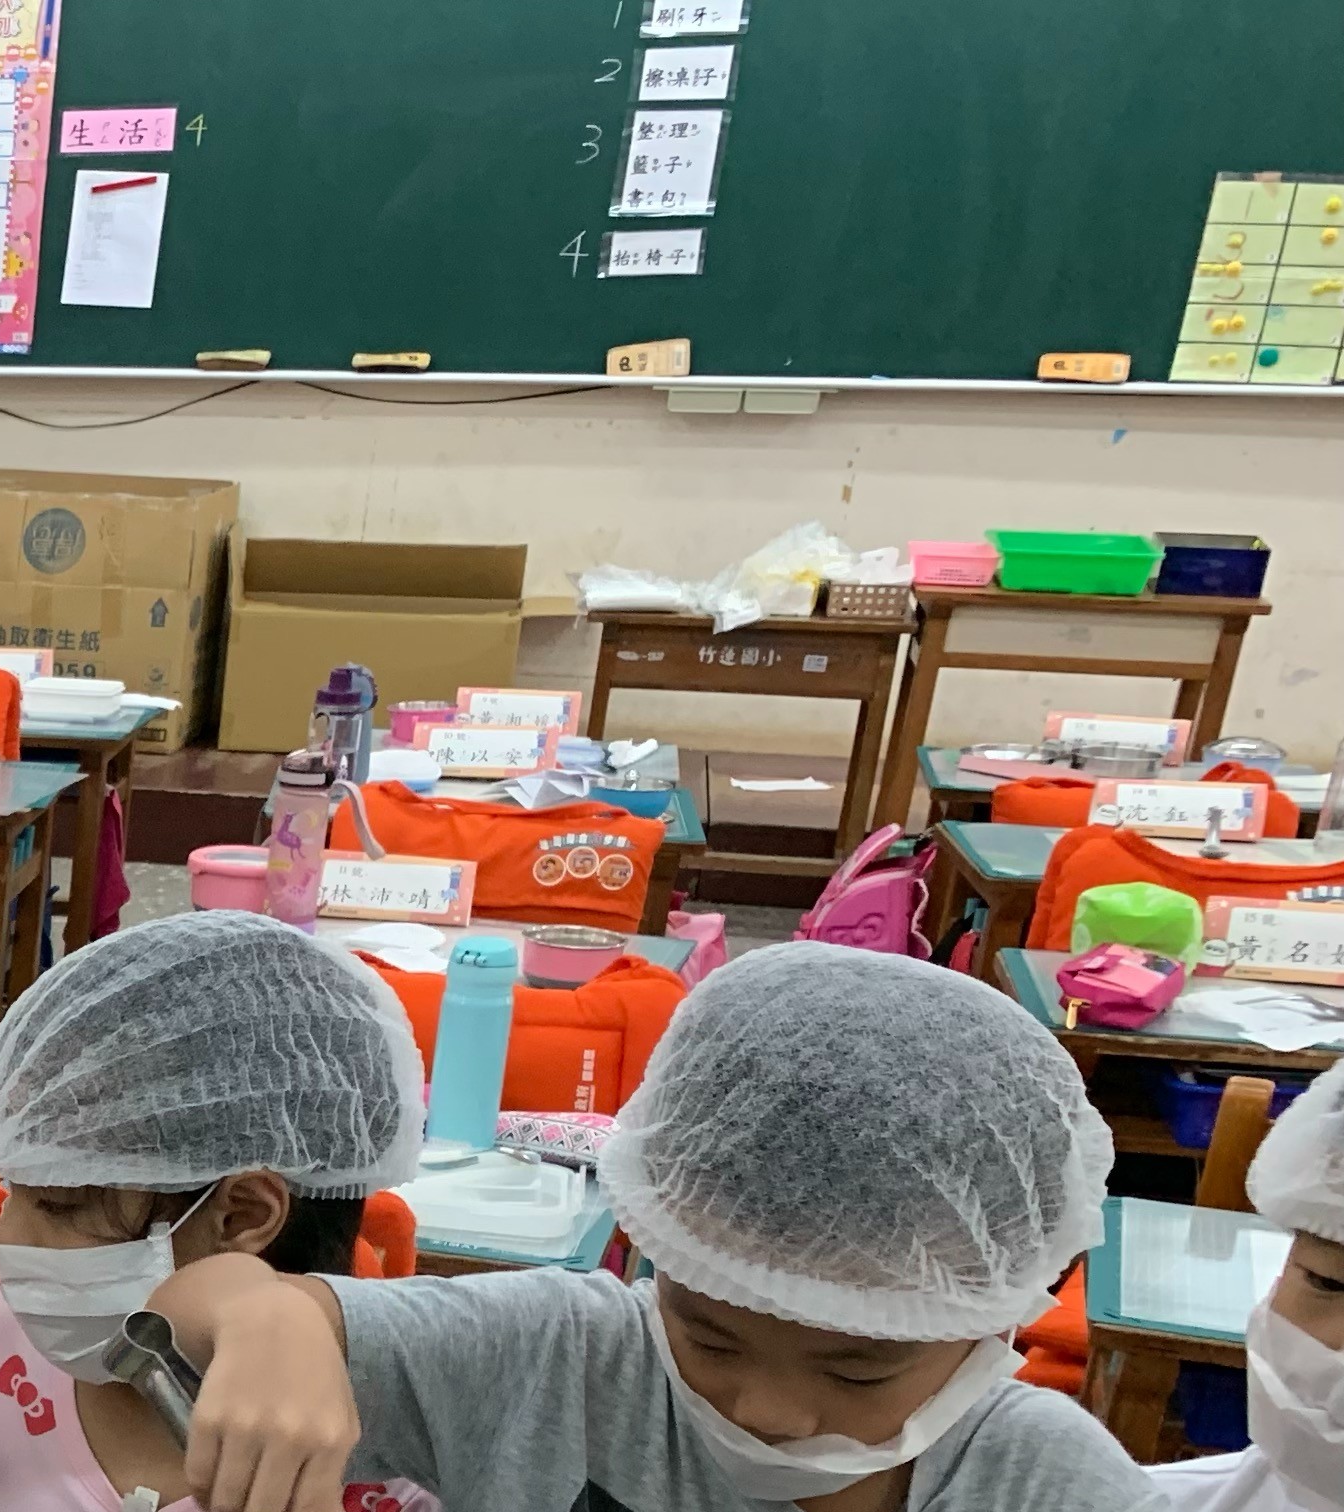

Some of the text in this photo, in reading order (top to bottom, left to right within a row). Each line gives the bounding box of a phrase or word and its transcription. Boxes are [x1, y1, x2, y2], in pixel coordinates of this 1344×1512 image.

[594, 58, 622, 83] 2
[644, 66, 718, 88] 擦桌子
[66, 118, 148, 148] 生活
[185, 113, 208, 148] 4
[636, 121, 690, 141] 整理
[575, 124, 603, 164] 3
[630, 155, 683, 175] 籃子
[626, 188, 676, 208] 書包
[559, 229, 589, 278] 4
[435, 747, 523, 766] 陳以安
